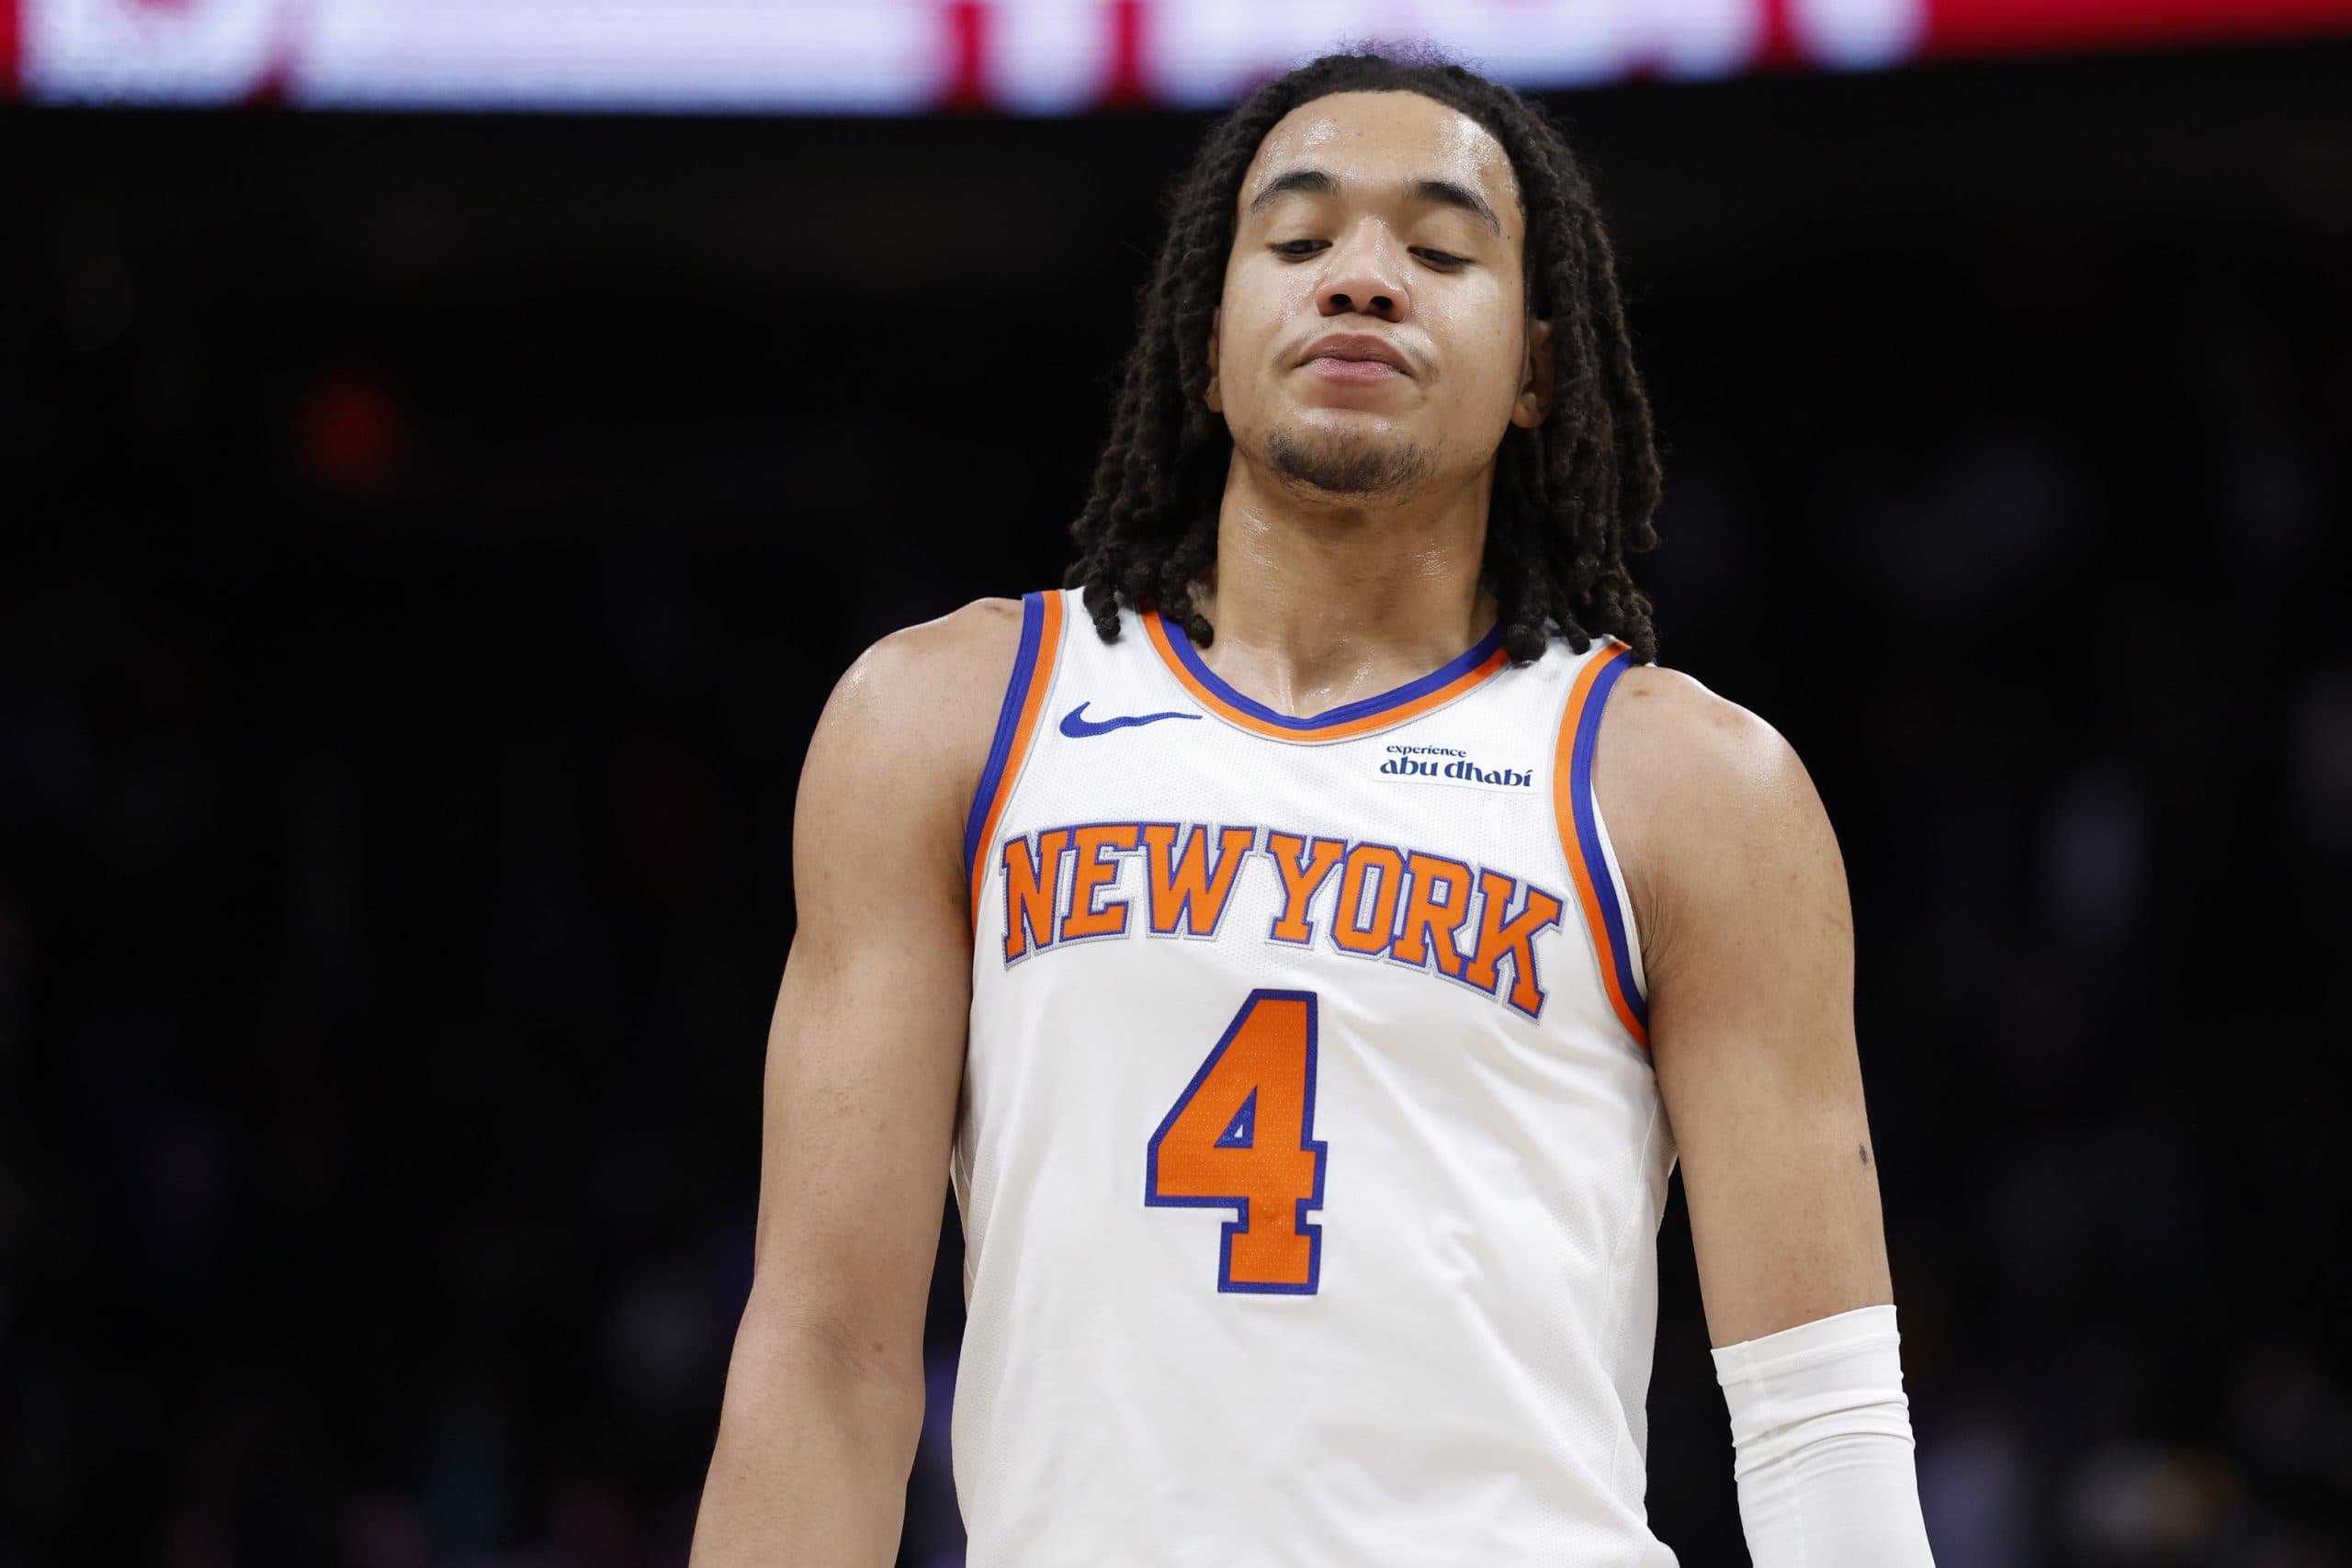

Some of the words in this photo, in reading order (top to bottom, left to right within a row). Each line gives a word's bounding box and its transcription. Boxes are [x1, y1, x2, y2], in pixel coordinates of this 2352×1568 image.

[1380, 756, 1439, 777] abu
[1386, 745, 1467, 758] experience
[1001, 821, 1255, 970] NEW
[1265, 829, 1564, 1023] YORK
[1145, 988, 1328, 1295] 4
